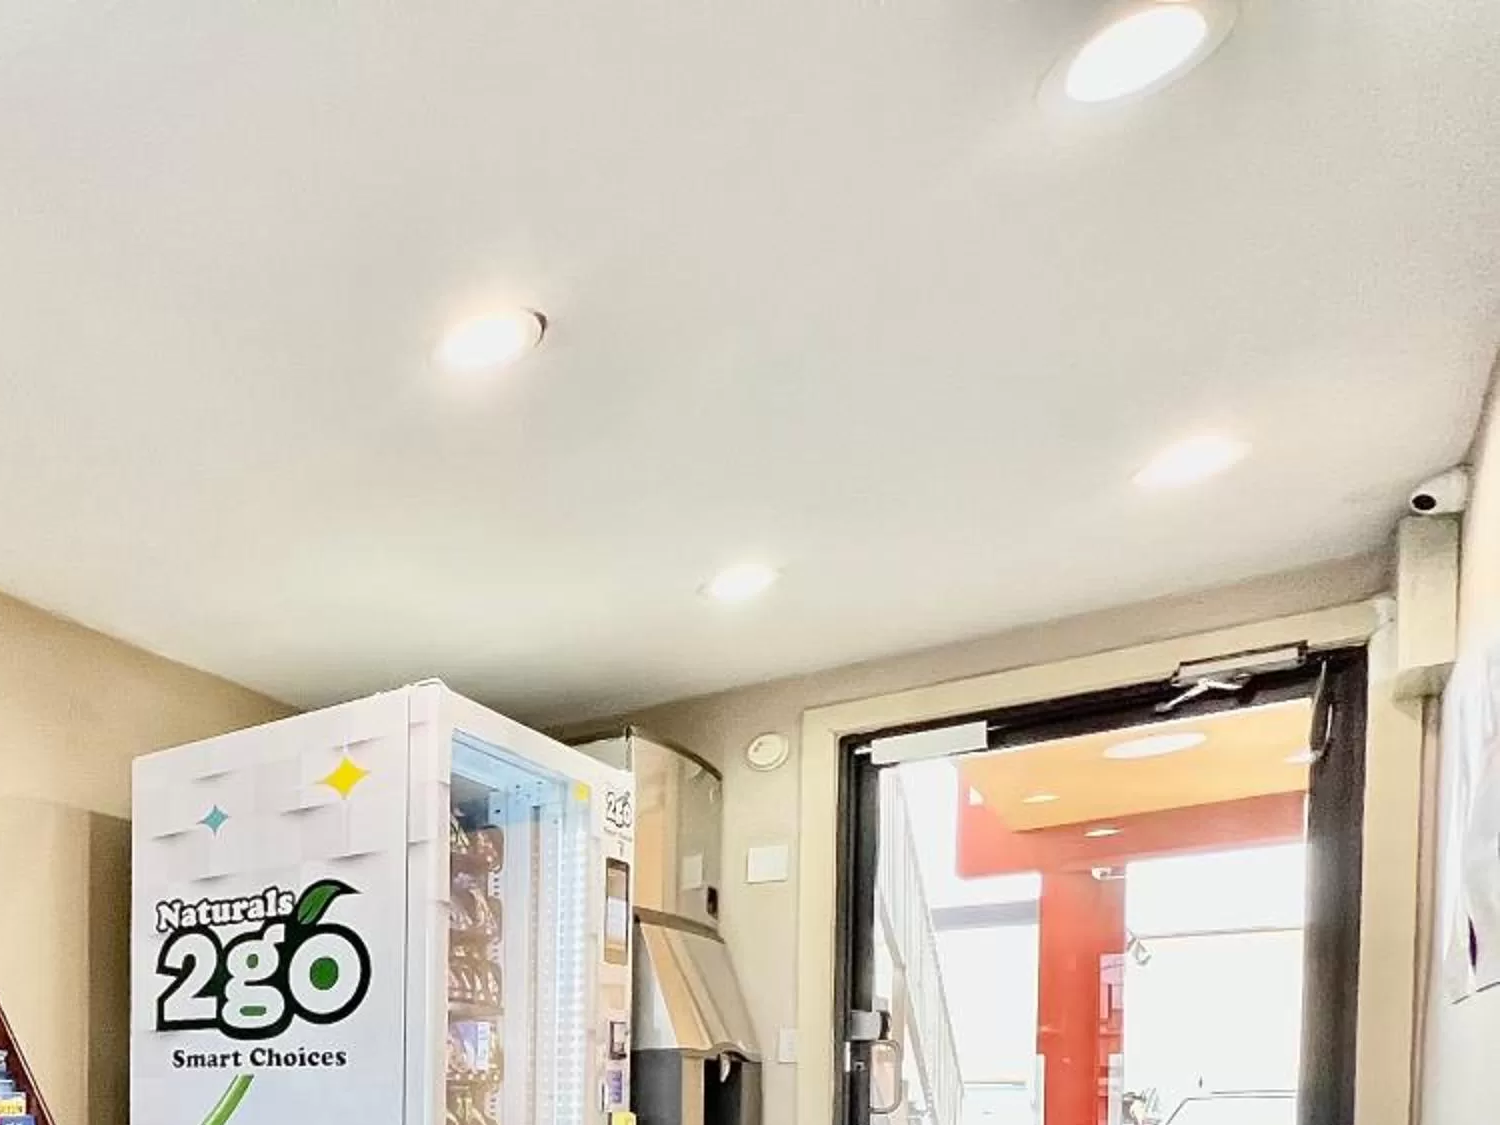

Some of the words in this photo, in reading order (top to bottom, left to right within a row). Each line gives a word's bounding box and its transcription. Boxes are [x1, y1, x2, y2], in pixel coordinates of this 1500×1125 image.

[156, 884, 295, 932] Naturals
[155, 922, 372, 1040] 2go
[172, 1049, 243, 1069] Smart
[249, 1047, 347, 1067] Choices
